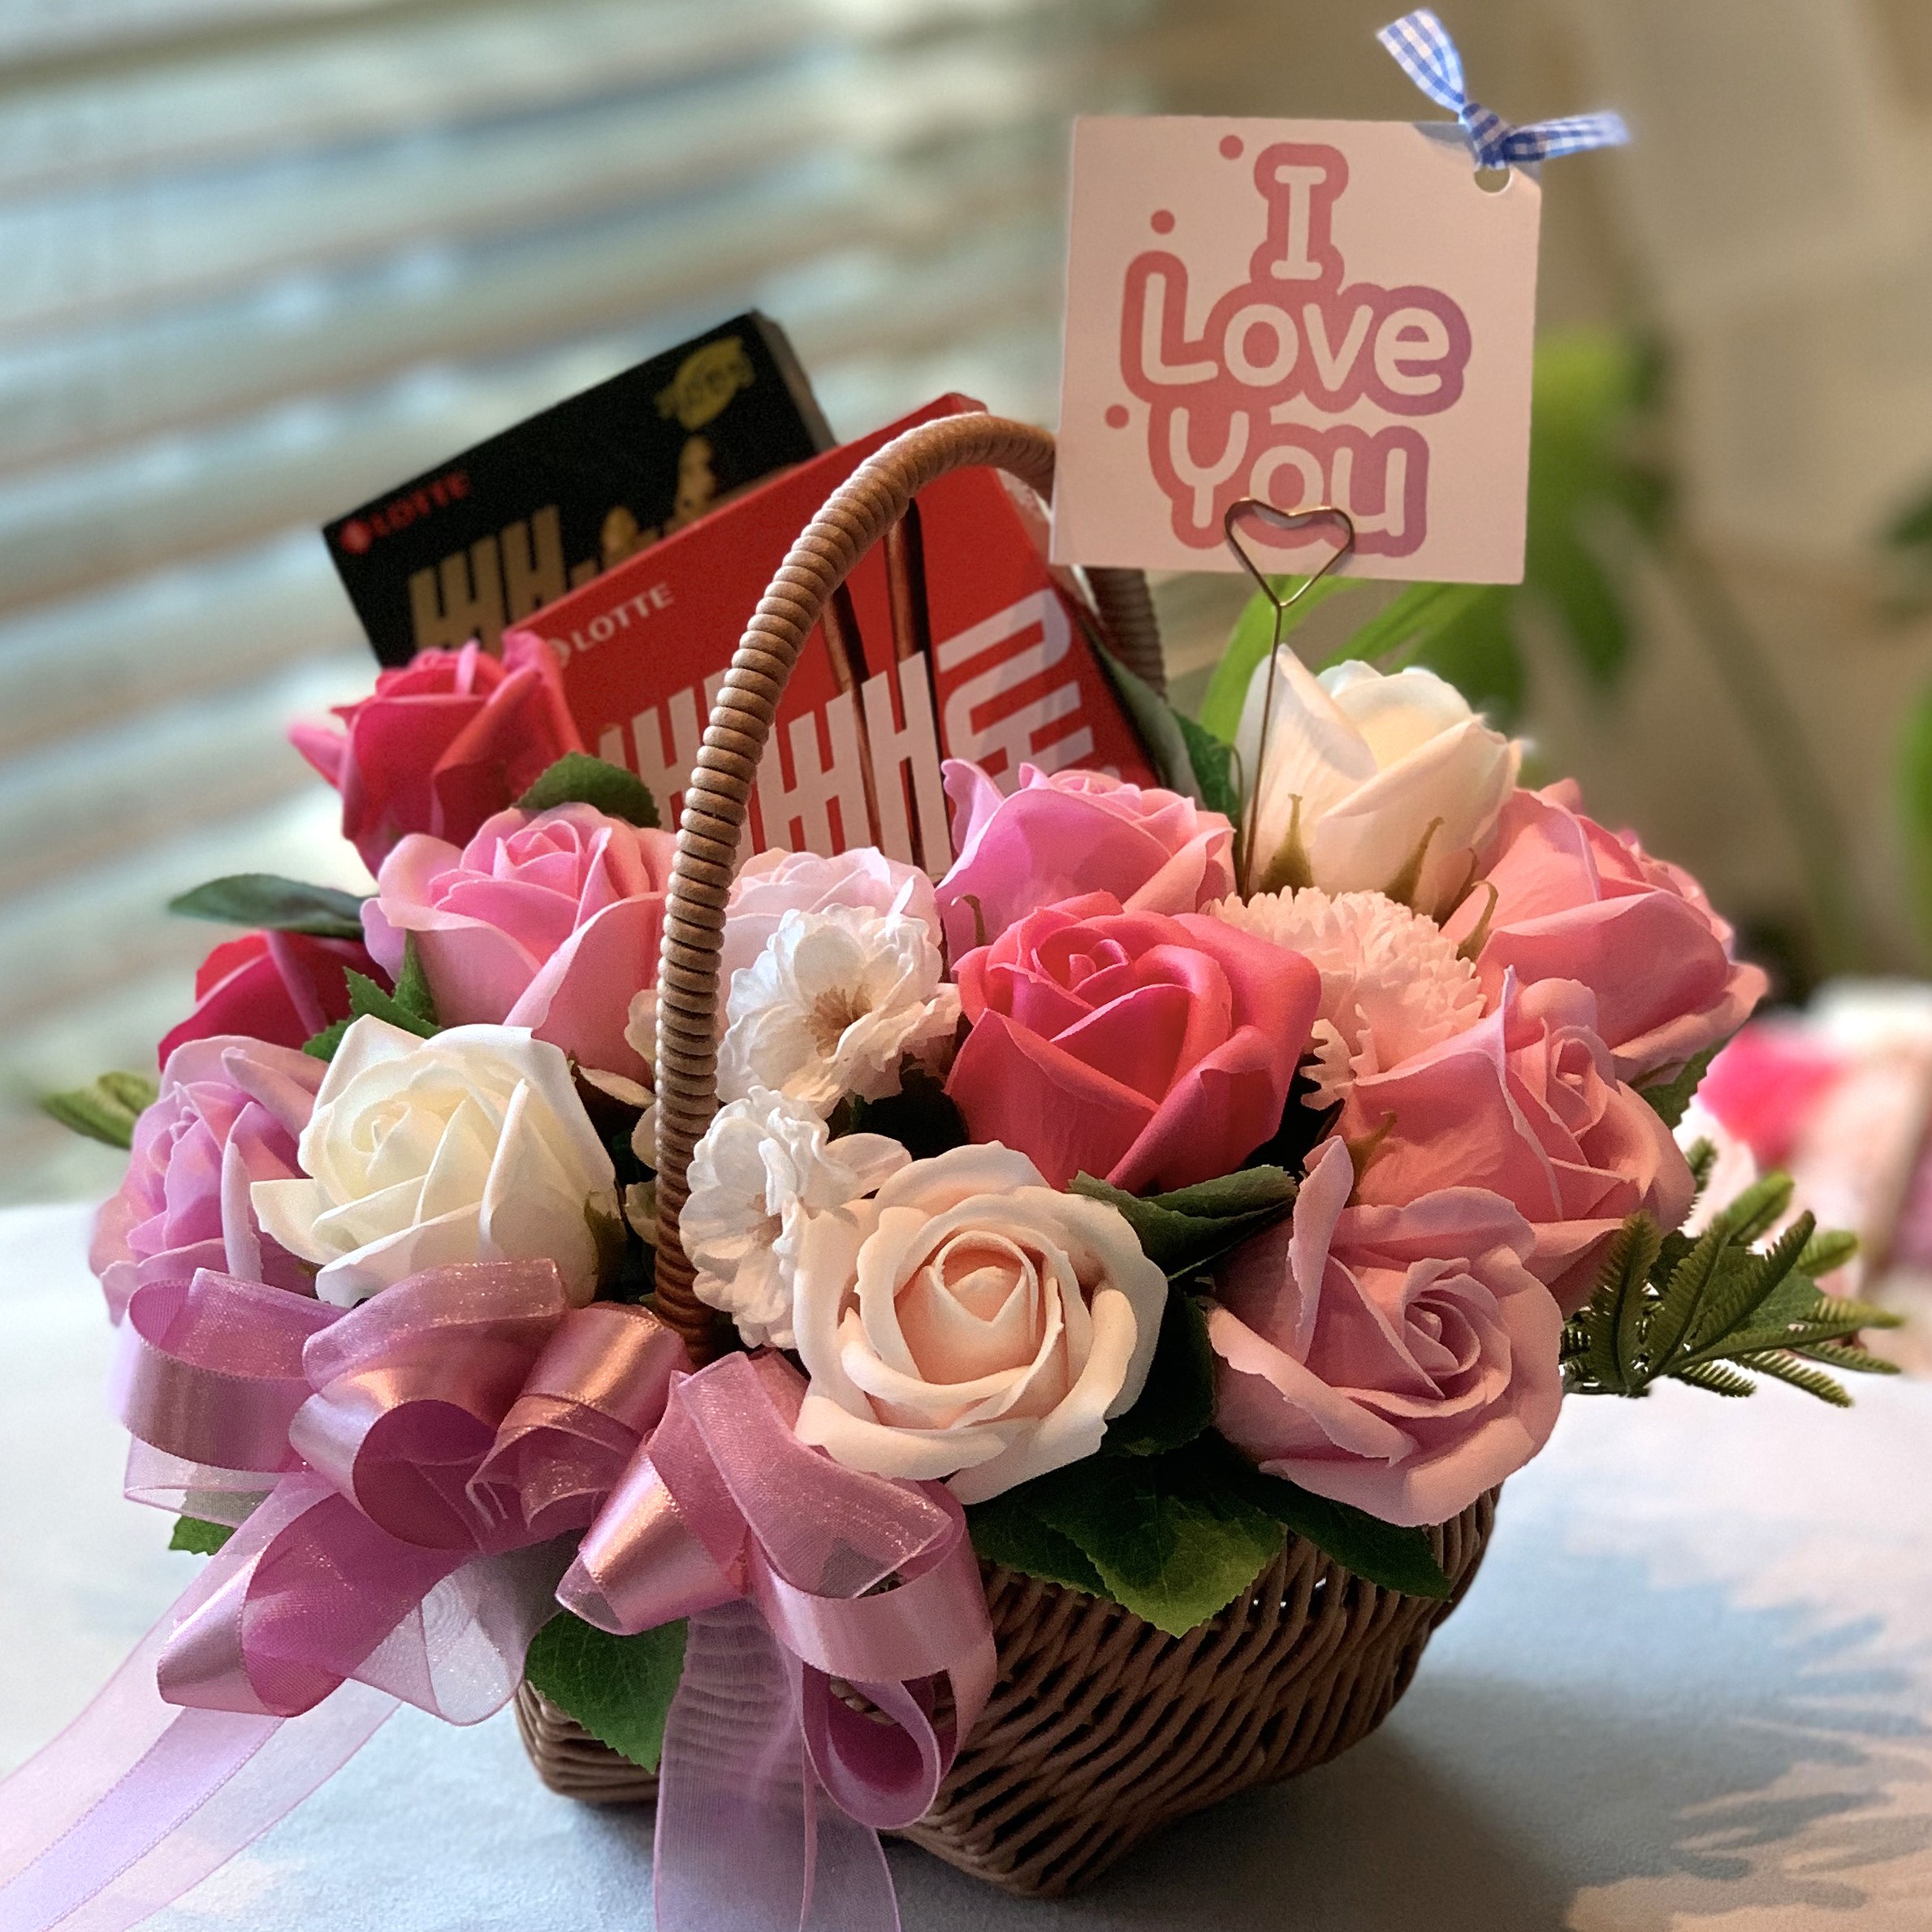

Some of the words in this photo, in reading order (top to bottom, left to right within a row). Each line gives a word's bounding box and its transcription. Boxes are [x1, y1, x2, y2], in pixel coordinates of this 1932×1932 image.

[1267, 162, 1331, 282] I
[1139, 271, 1450, 396] Love
[1168, 406, 1408, 538] You
[571, 582, 674, 654] LOTTE
